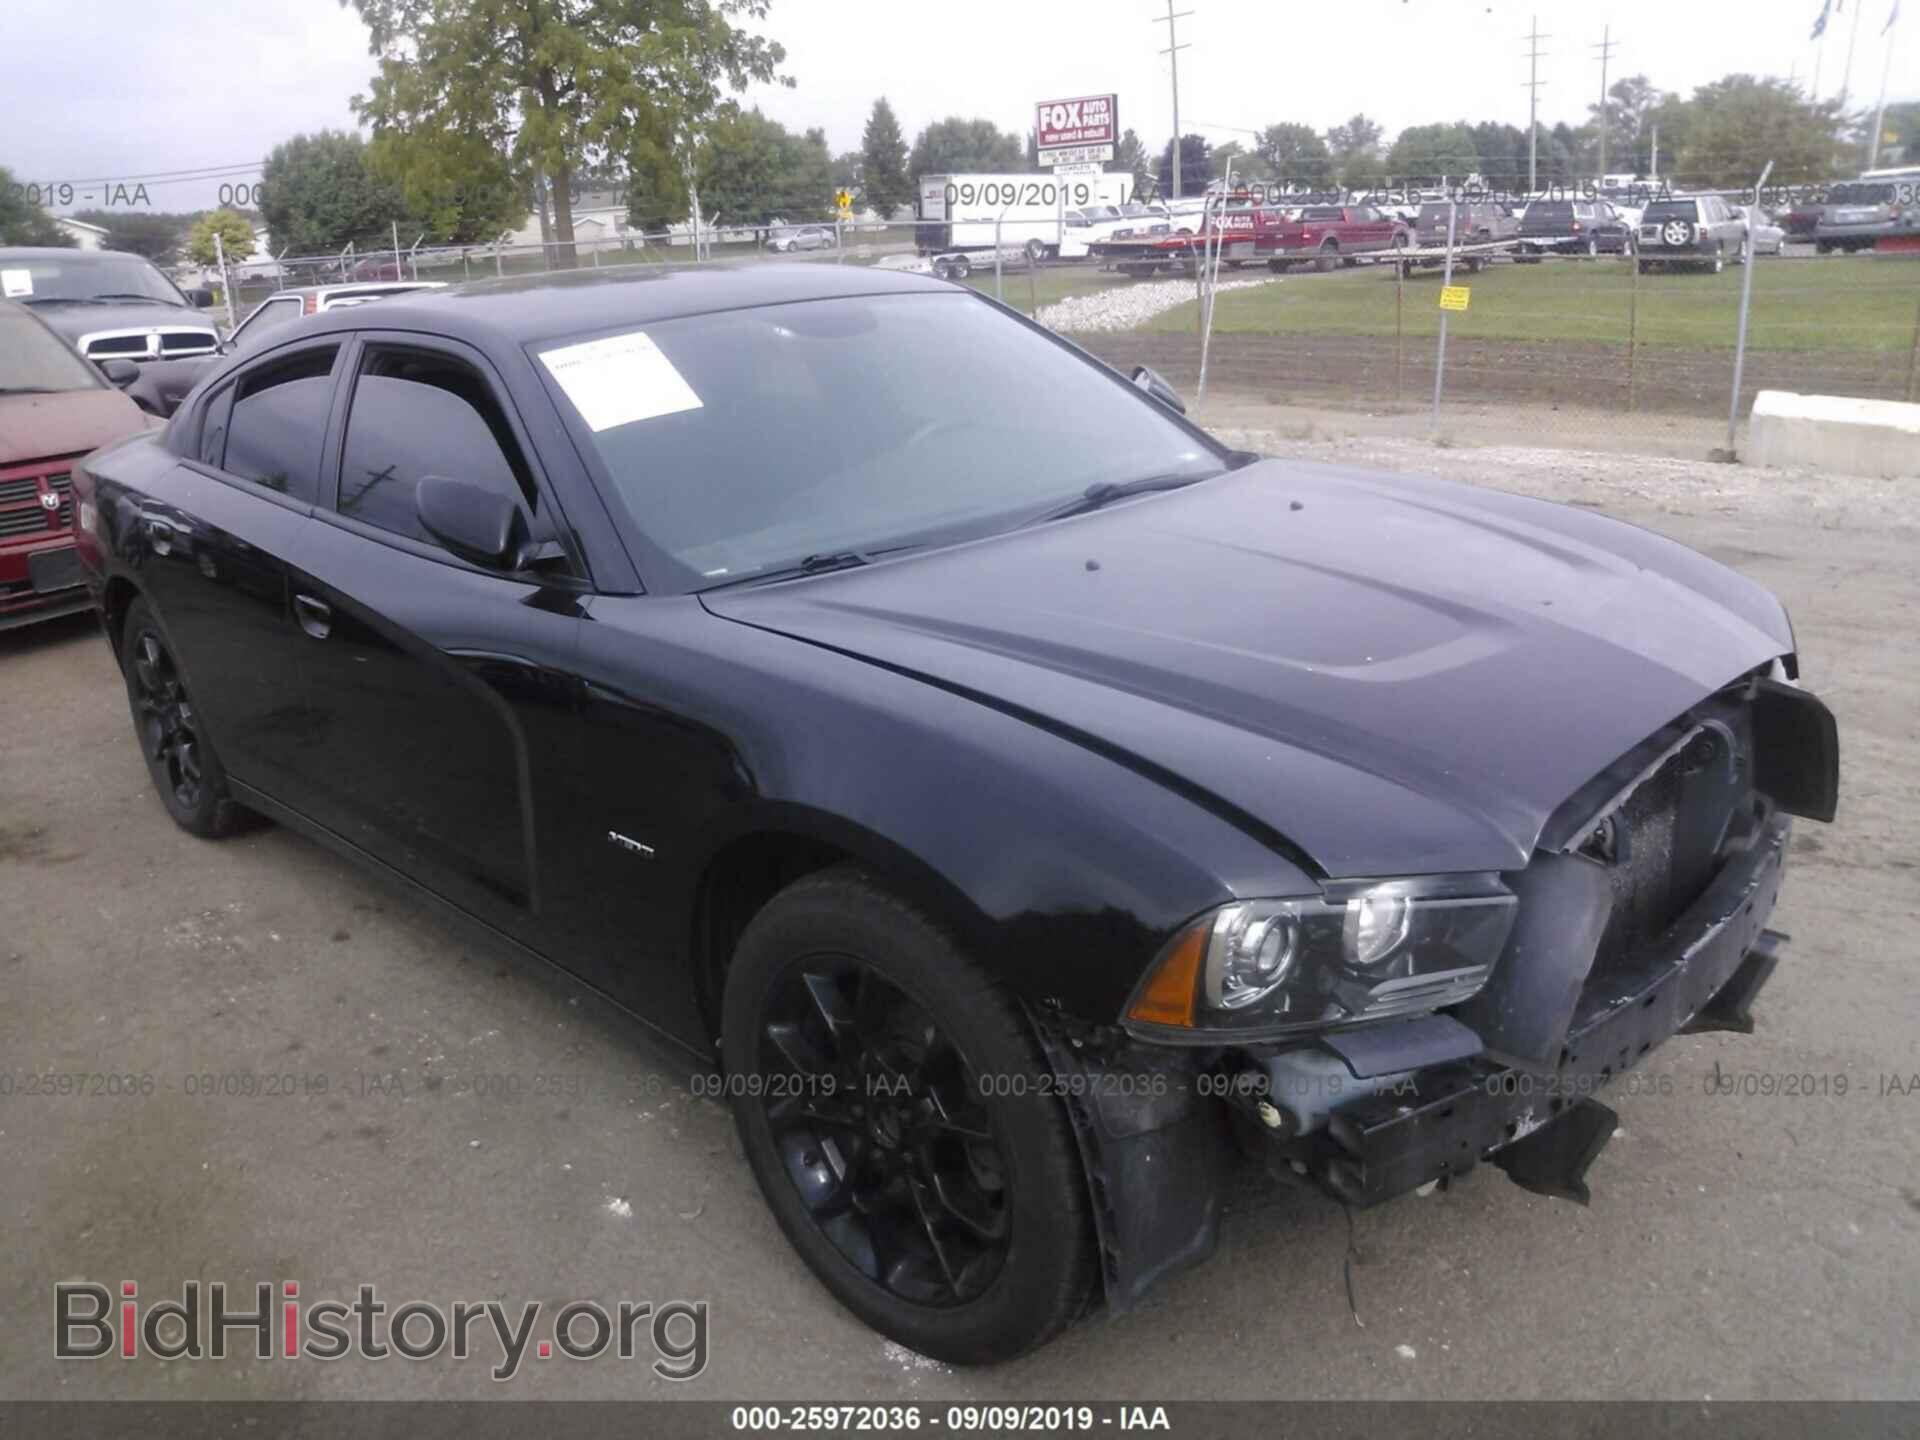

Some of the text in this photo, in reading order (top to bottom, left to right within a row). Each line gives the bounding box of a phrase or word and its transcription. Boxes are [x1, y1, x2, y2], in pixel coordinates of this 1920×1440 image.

[1040, 100, 1107, 132] FOX AUTO
[1083, 113, 1110, 128] PARTS
